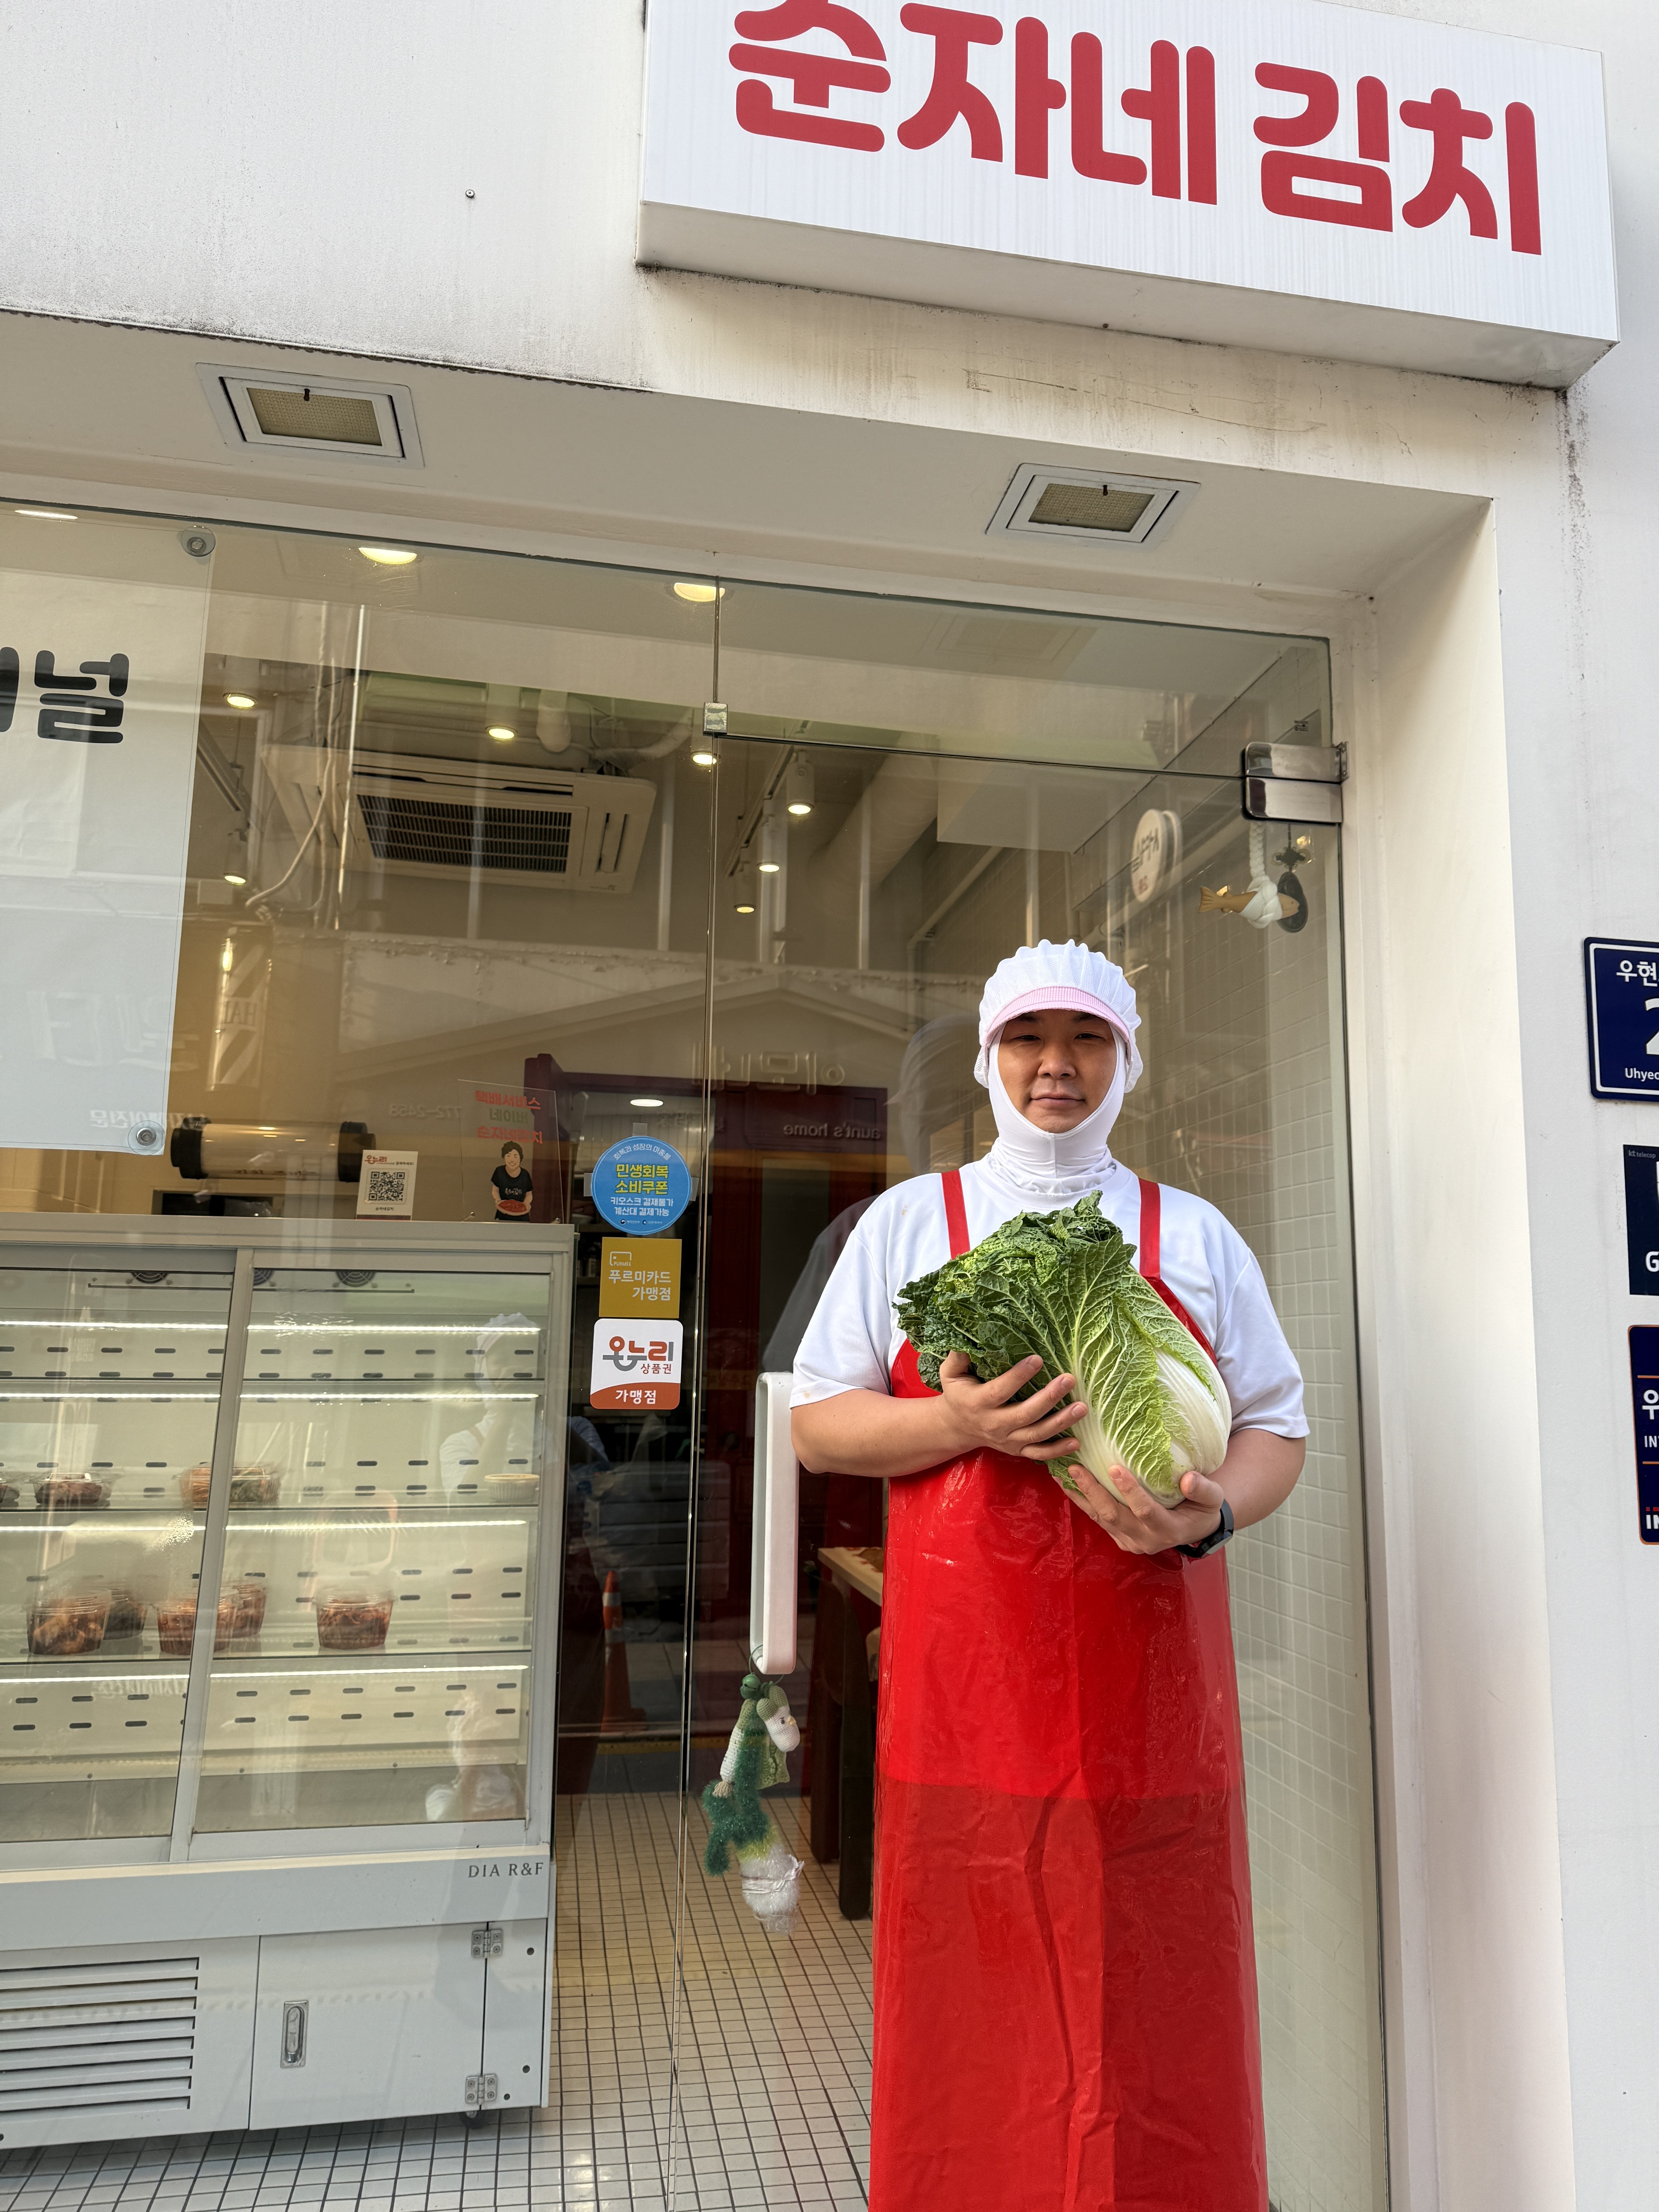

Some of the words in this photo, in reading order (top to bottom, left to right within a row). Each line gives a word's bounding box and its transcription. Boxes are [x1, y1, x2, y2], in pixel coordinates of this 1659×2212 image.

[728, 0, 1217, 205] 순자네
[1253, 62, 1542, 256] 김치
[0, 647, 129, 744] 널
[1616, 960, 1659, 987] 우현
[475, 1090, 541, 1110] 택배서비스
[489, 1108, 528, 1123] 네이버
[613, 1145, 632, 1160] 회복과
[616, 1164, 669, 1179] 민생회복
[615, 1180, 668, 1195] 소비쿠폰
[610, 1197, 641, 1206] 키오스크
[614, 1207, 637, 1215] 계산대
[639, 1207, 670, 1216] 결제가능
[608, 1270, 671, 1285] 푸르미카드
[632, 1286, 671, 1301] 가맹점
[641, 1364, 672, 1374] 상품권
[615, 1389, 656, 1405] 가맹점
[1644, 1436, 1659, 1448] IN
[468, 1864, 500, 1878] DIA
[508, 1862, 544, 1876] R&F
